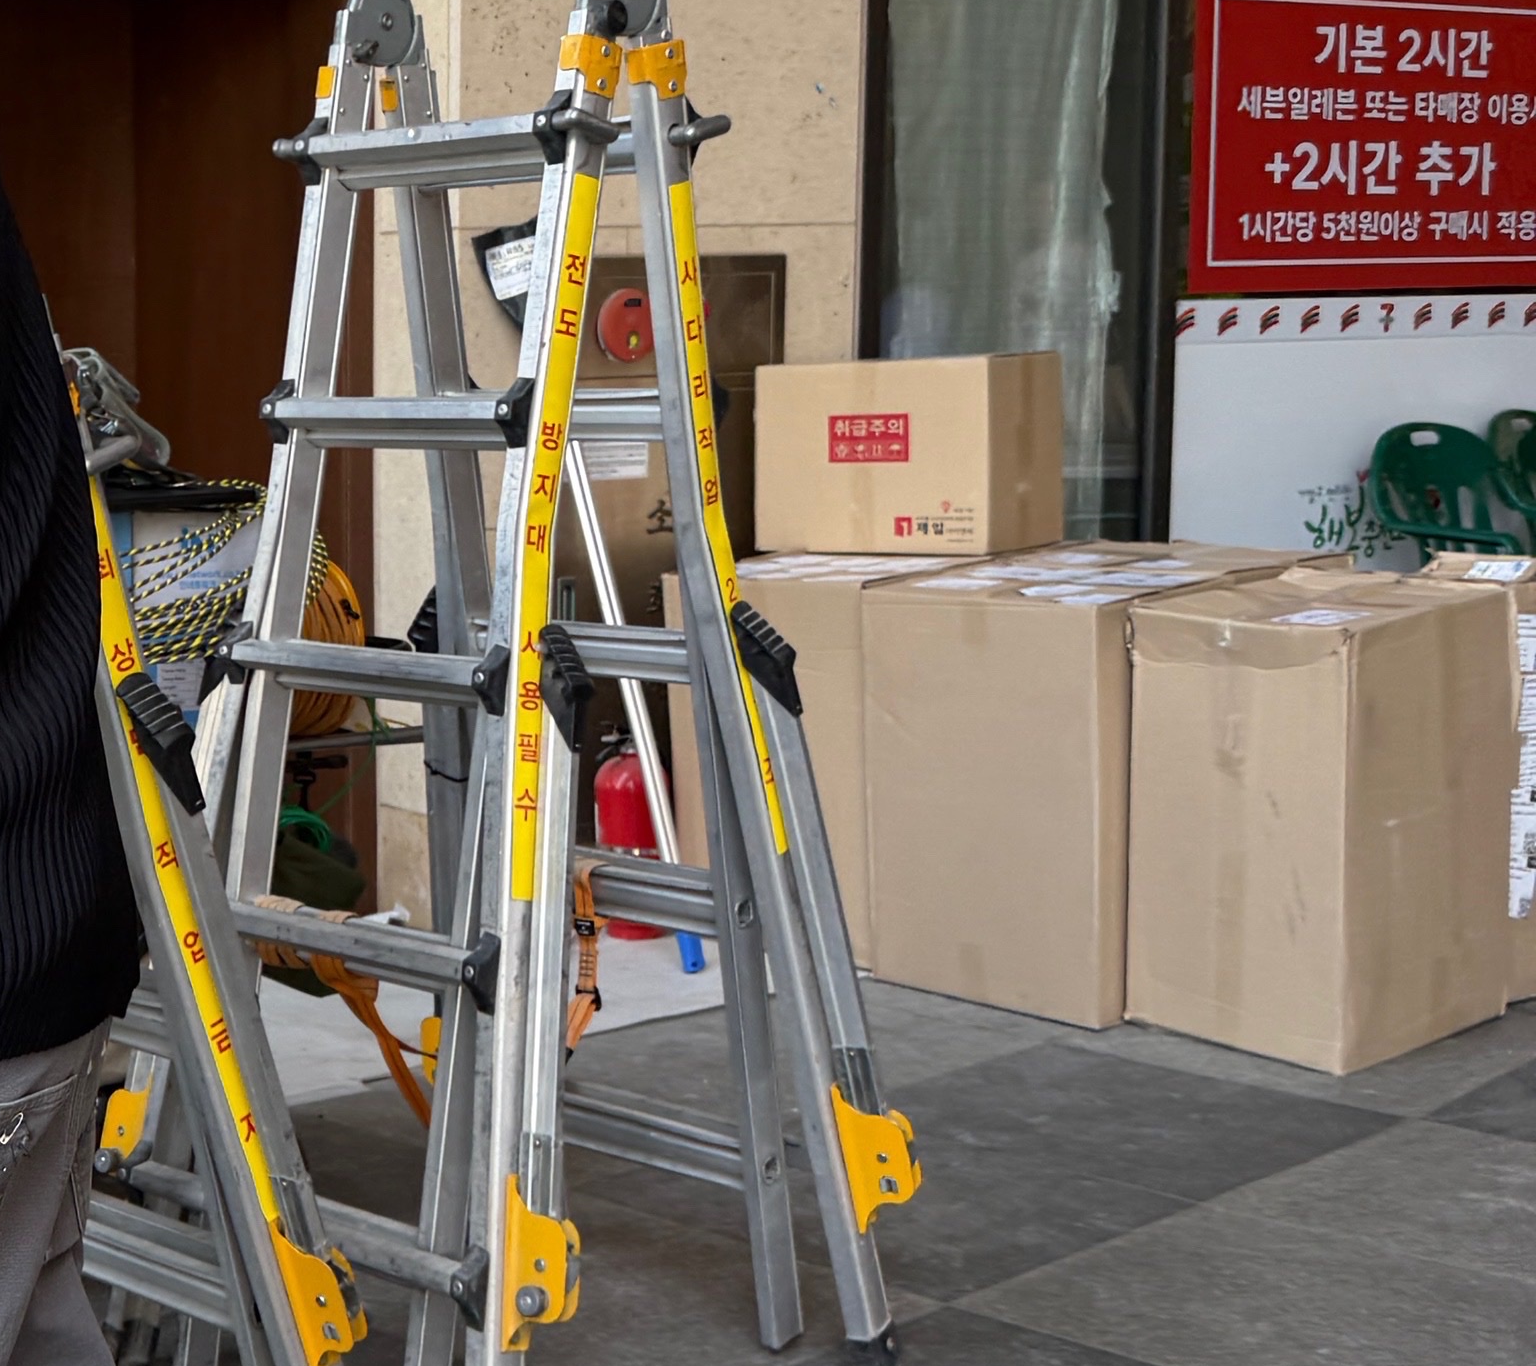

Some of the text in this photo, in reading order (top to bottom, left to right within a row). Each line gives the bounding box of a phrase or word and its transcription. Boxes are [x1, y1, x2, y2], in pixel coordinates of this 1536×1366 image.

[1314, 23, 1494, 79] 기본 2시간
[1236, 84, 1359, 122] 세븐일레븐
[1364, 91, 1409, 122] 또는
[1413, 91, 1482, 125] 타매장
[1265, 139, 1497, 198] +2시간 추가
[1238, 211, 1317, 243] 1시간당
[1321, 210, 1421, 243] 5천원이상
[1426, 209, 1490, 242] 구매시
[554, 253, 588, 339] 전도
[680, 259, 721, 508] 사다리작업
[834, 418, 904, 438] 취급주의
[526, 421, 564, 555] 방지대
